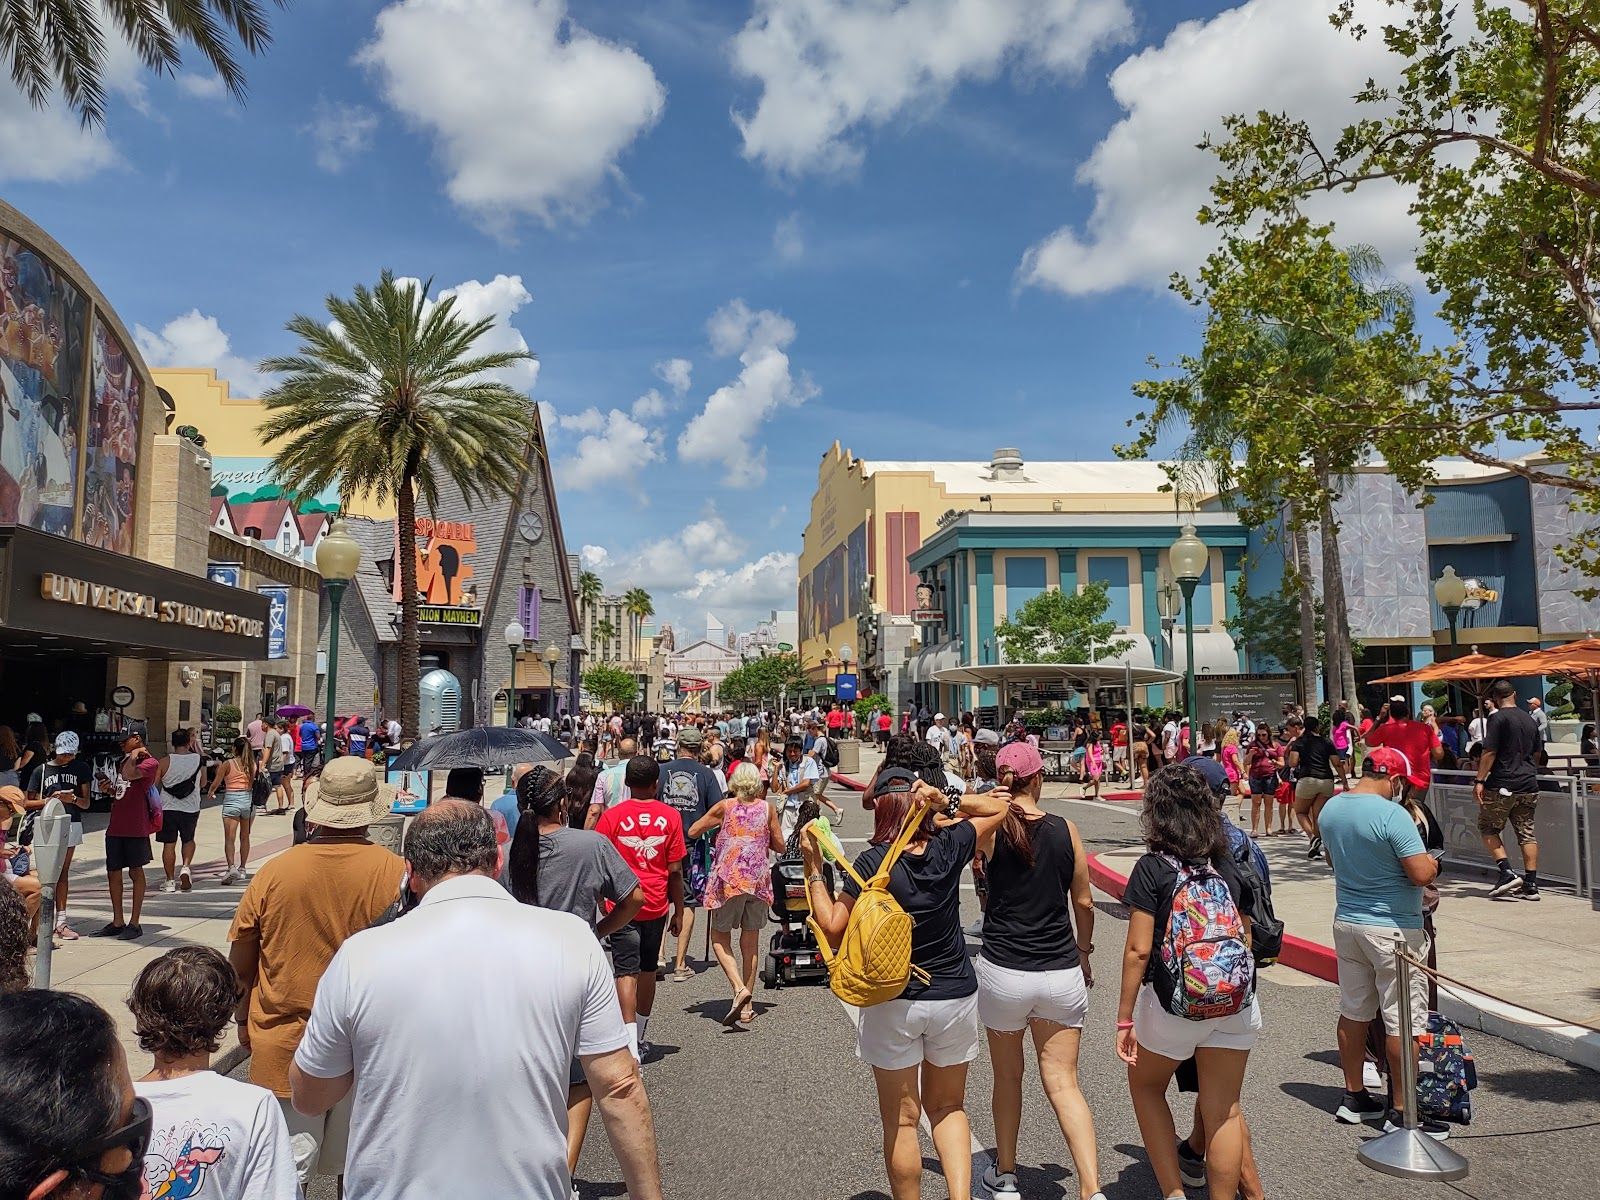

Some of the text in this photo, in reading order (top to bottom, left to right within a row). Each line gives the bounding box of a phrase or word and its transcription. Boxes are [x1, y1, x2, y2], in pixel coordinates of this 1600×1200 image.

[210, 469, 266, 489] great
[414, 517, 476, 541] SPICABLE
[41, 572, 264, 638] UNIVERSAL STUDIOS STORE
[443, 610, 478, 624] MAYHEM
[44, 773, 78, 789] NEW YORK
[620, 813, 667, 831] USA
